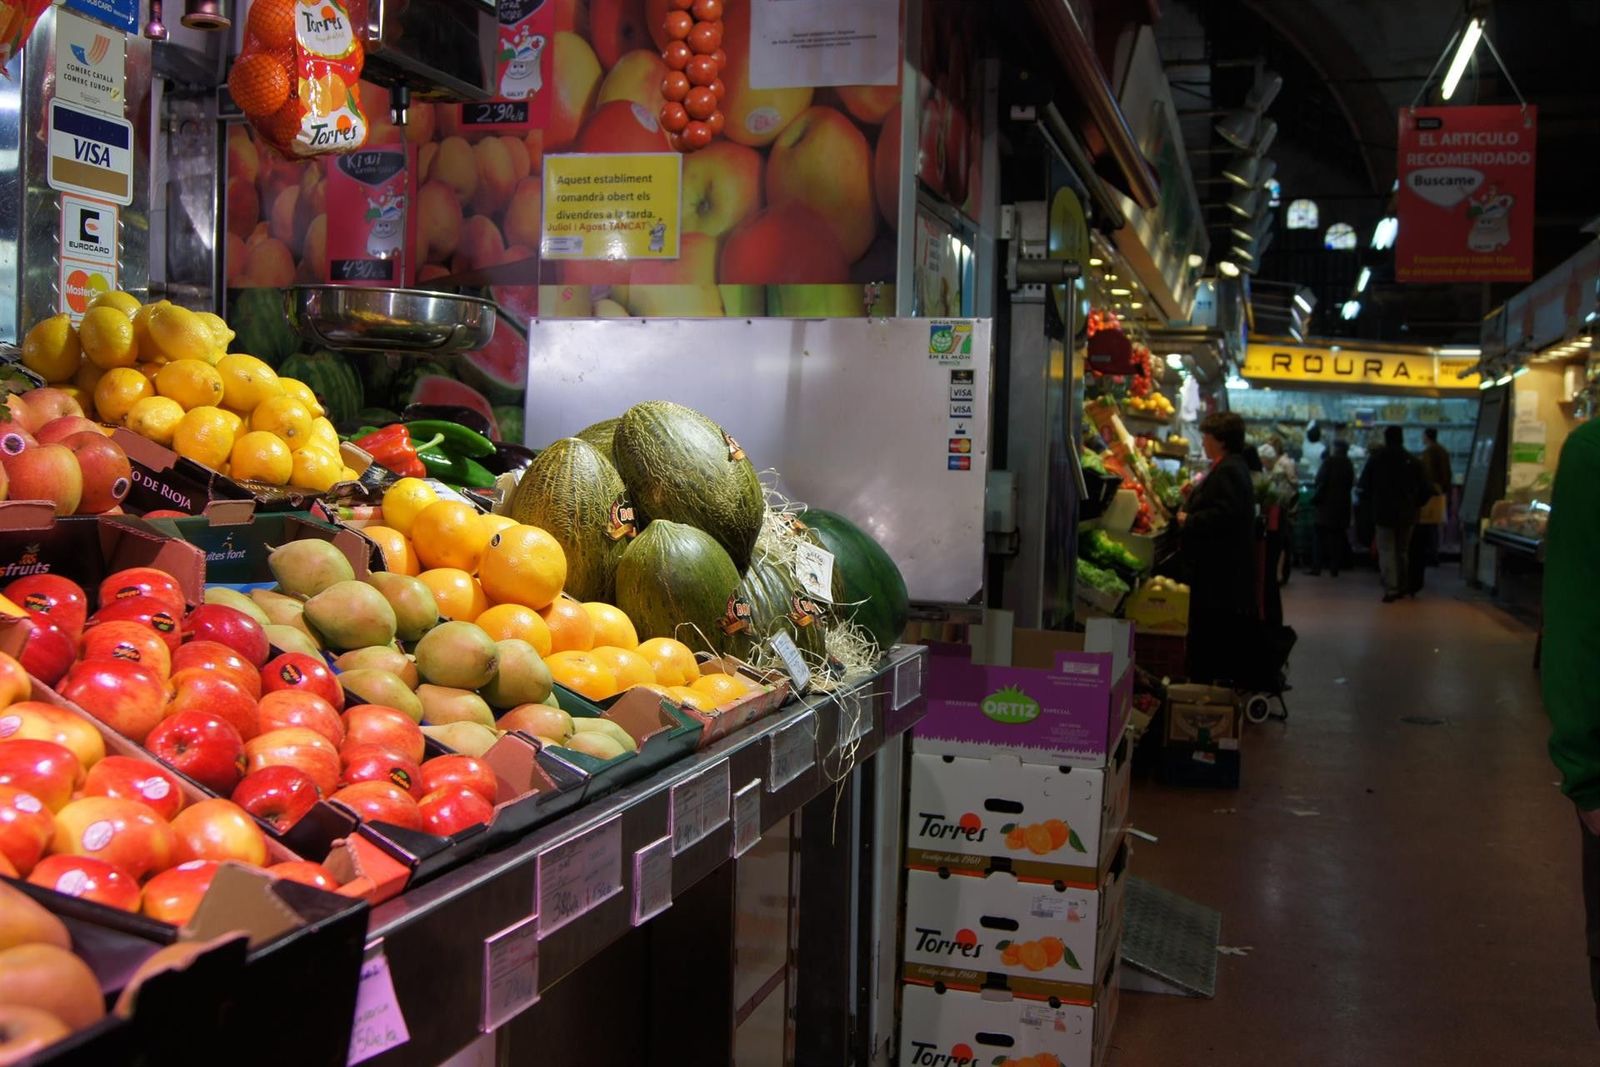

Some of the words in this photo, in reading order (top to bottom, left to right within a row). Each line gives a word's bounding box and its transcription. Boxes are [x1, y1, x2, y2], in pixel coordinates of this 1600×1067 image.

[302, 11, 343, 32] Torres
[310, 123, 358, 146] Torres
[1419, 133, 1436, 146] EL
[1441, 131, 1519, 145] ARTICULO
[74, 138, 111, 168] VISA
[1407, 152, 1530, 165] RECOMENDADO
[557, 175, 591, 186] Aquest
[593, 174, 653, 184] establiment
[1414, 175, 1475, 186] Buscame
[607, 192, 634, 201] obert
[636, 191, 651, 201] els
[556, 210, 604, 220] divendres
[615, 209, 625, 219] la
[547, 222, 572, 232] Juliol
[579, 222, 606, 233] Agost
[609, 221, 647, 231] TANCAT
[69, 240, 110, 254] EUROCARD
[1271, 353, 1411, 379] ROURA
[954, 388, 972, 397] VISA
[953, 405, 972, 413] VISA
[143, 477, 159, 492] DE
[161, 483, 192, 509] RIOJA
[983, 700, 1037, 719] ORTIZ
[918, 812, 988, 843] Torres
[915, 927, 985, 958] Torres
